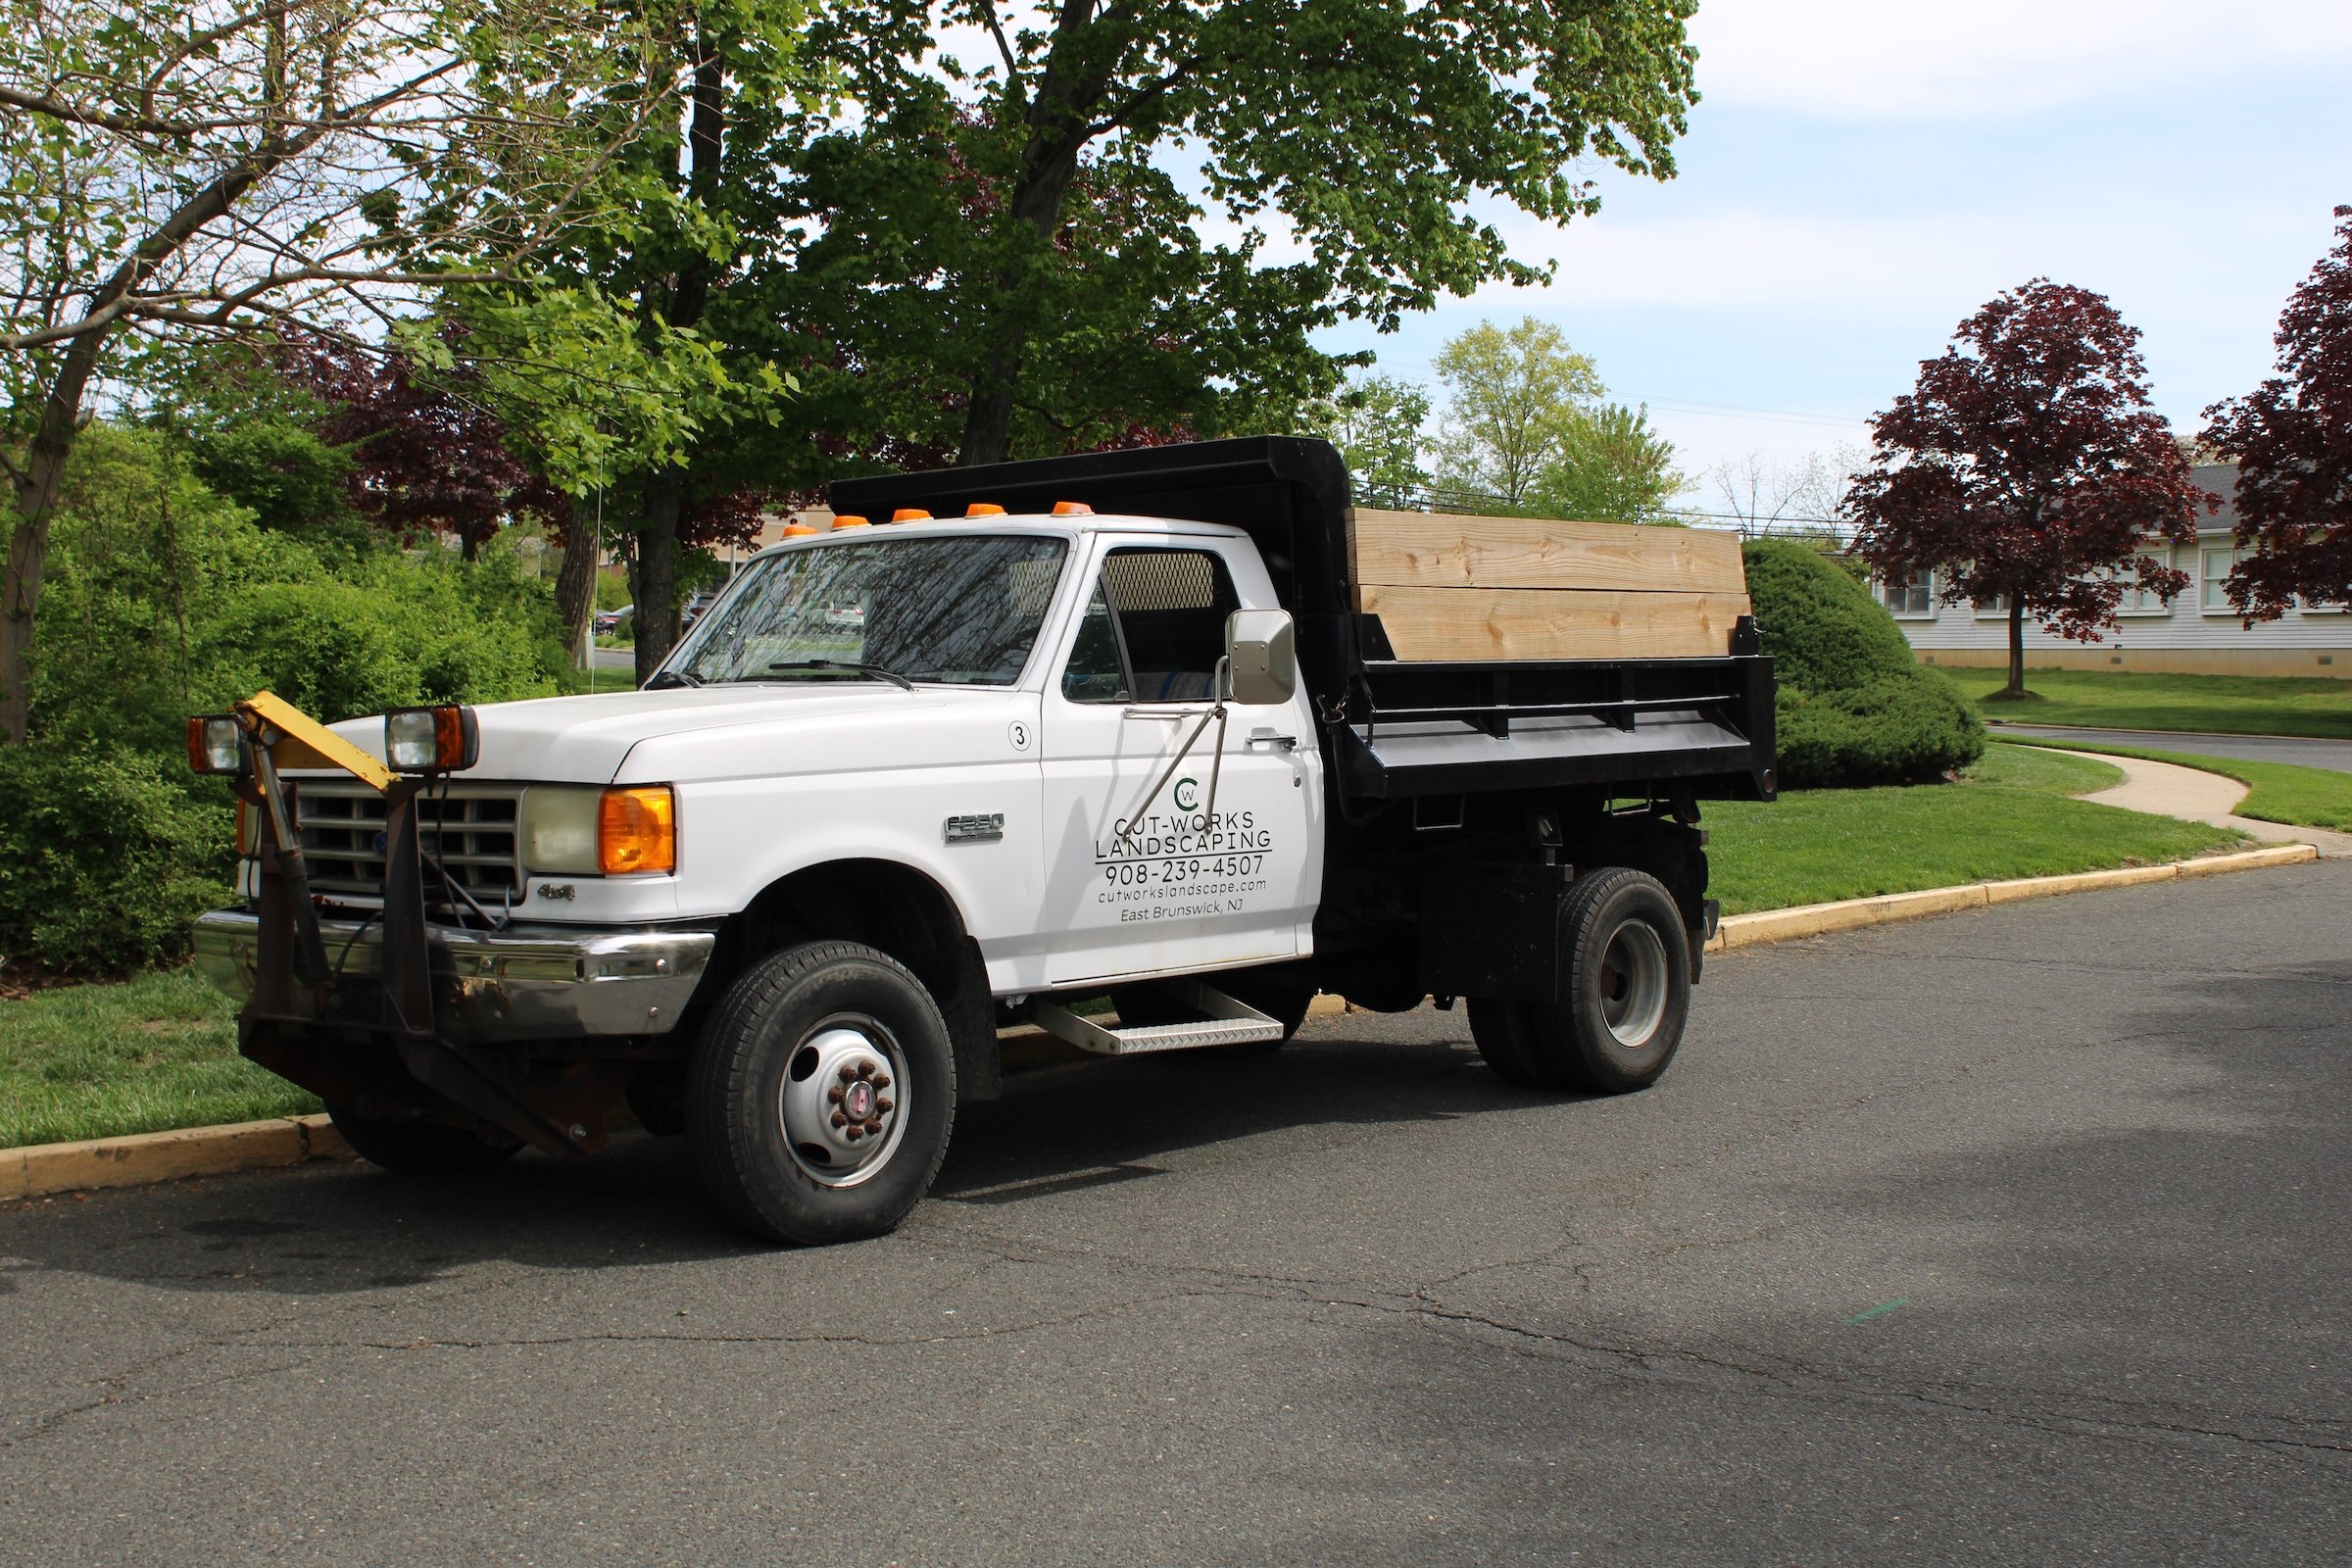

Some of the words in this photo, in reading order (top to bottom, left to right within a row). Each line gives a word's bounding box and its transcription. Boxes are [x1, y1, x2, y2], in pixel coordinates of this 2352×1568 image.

[1014, 725, 1025, 745] 3
[1114, 811, 1253, 836] CUT-WORKS
[1096, 830, 1271, 858] LANDSCAPING
[1105, 855, 1263, 887] 908-239-4507
[1099, 878, 1267, 904] cutworkslandscape.com
[1121, 908, 1150, 922] East
[1152, 901, 1224, 919] Brunswick,
[1227, 898, 1244, 911] NJ
